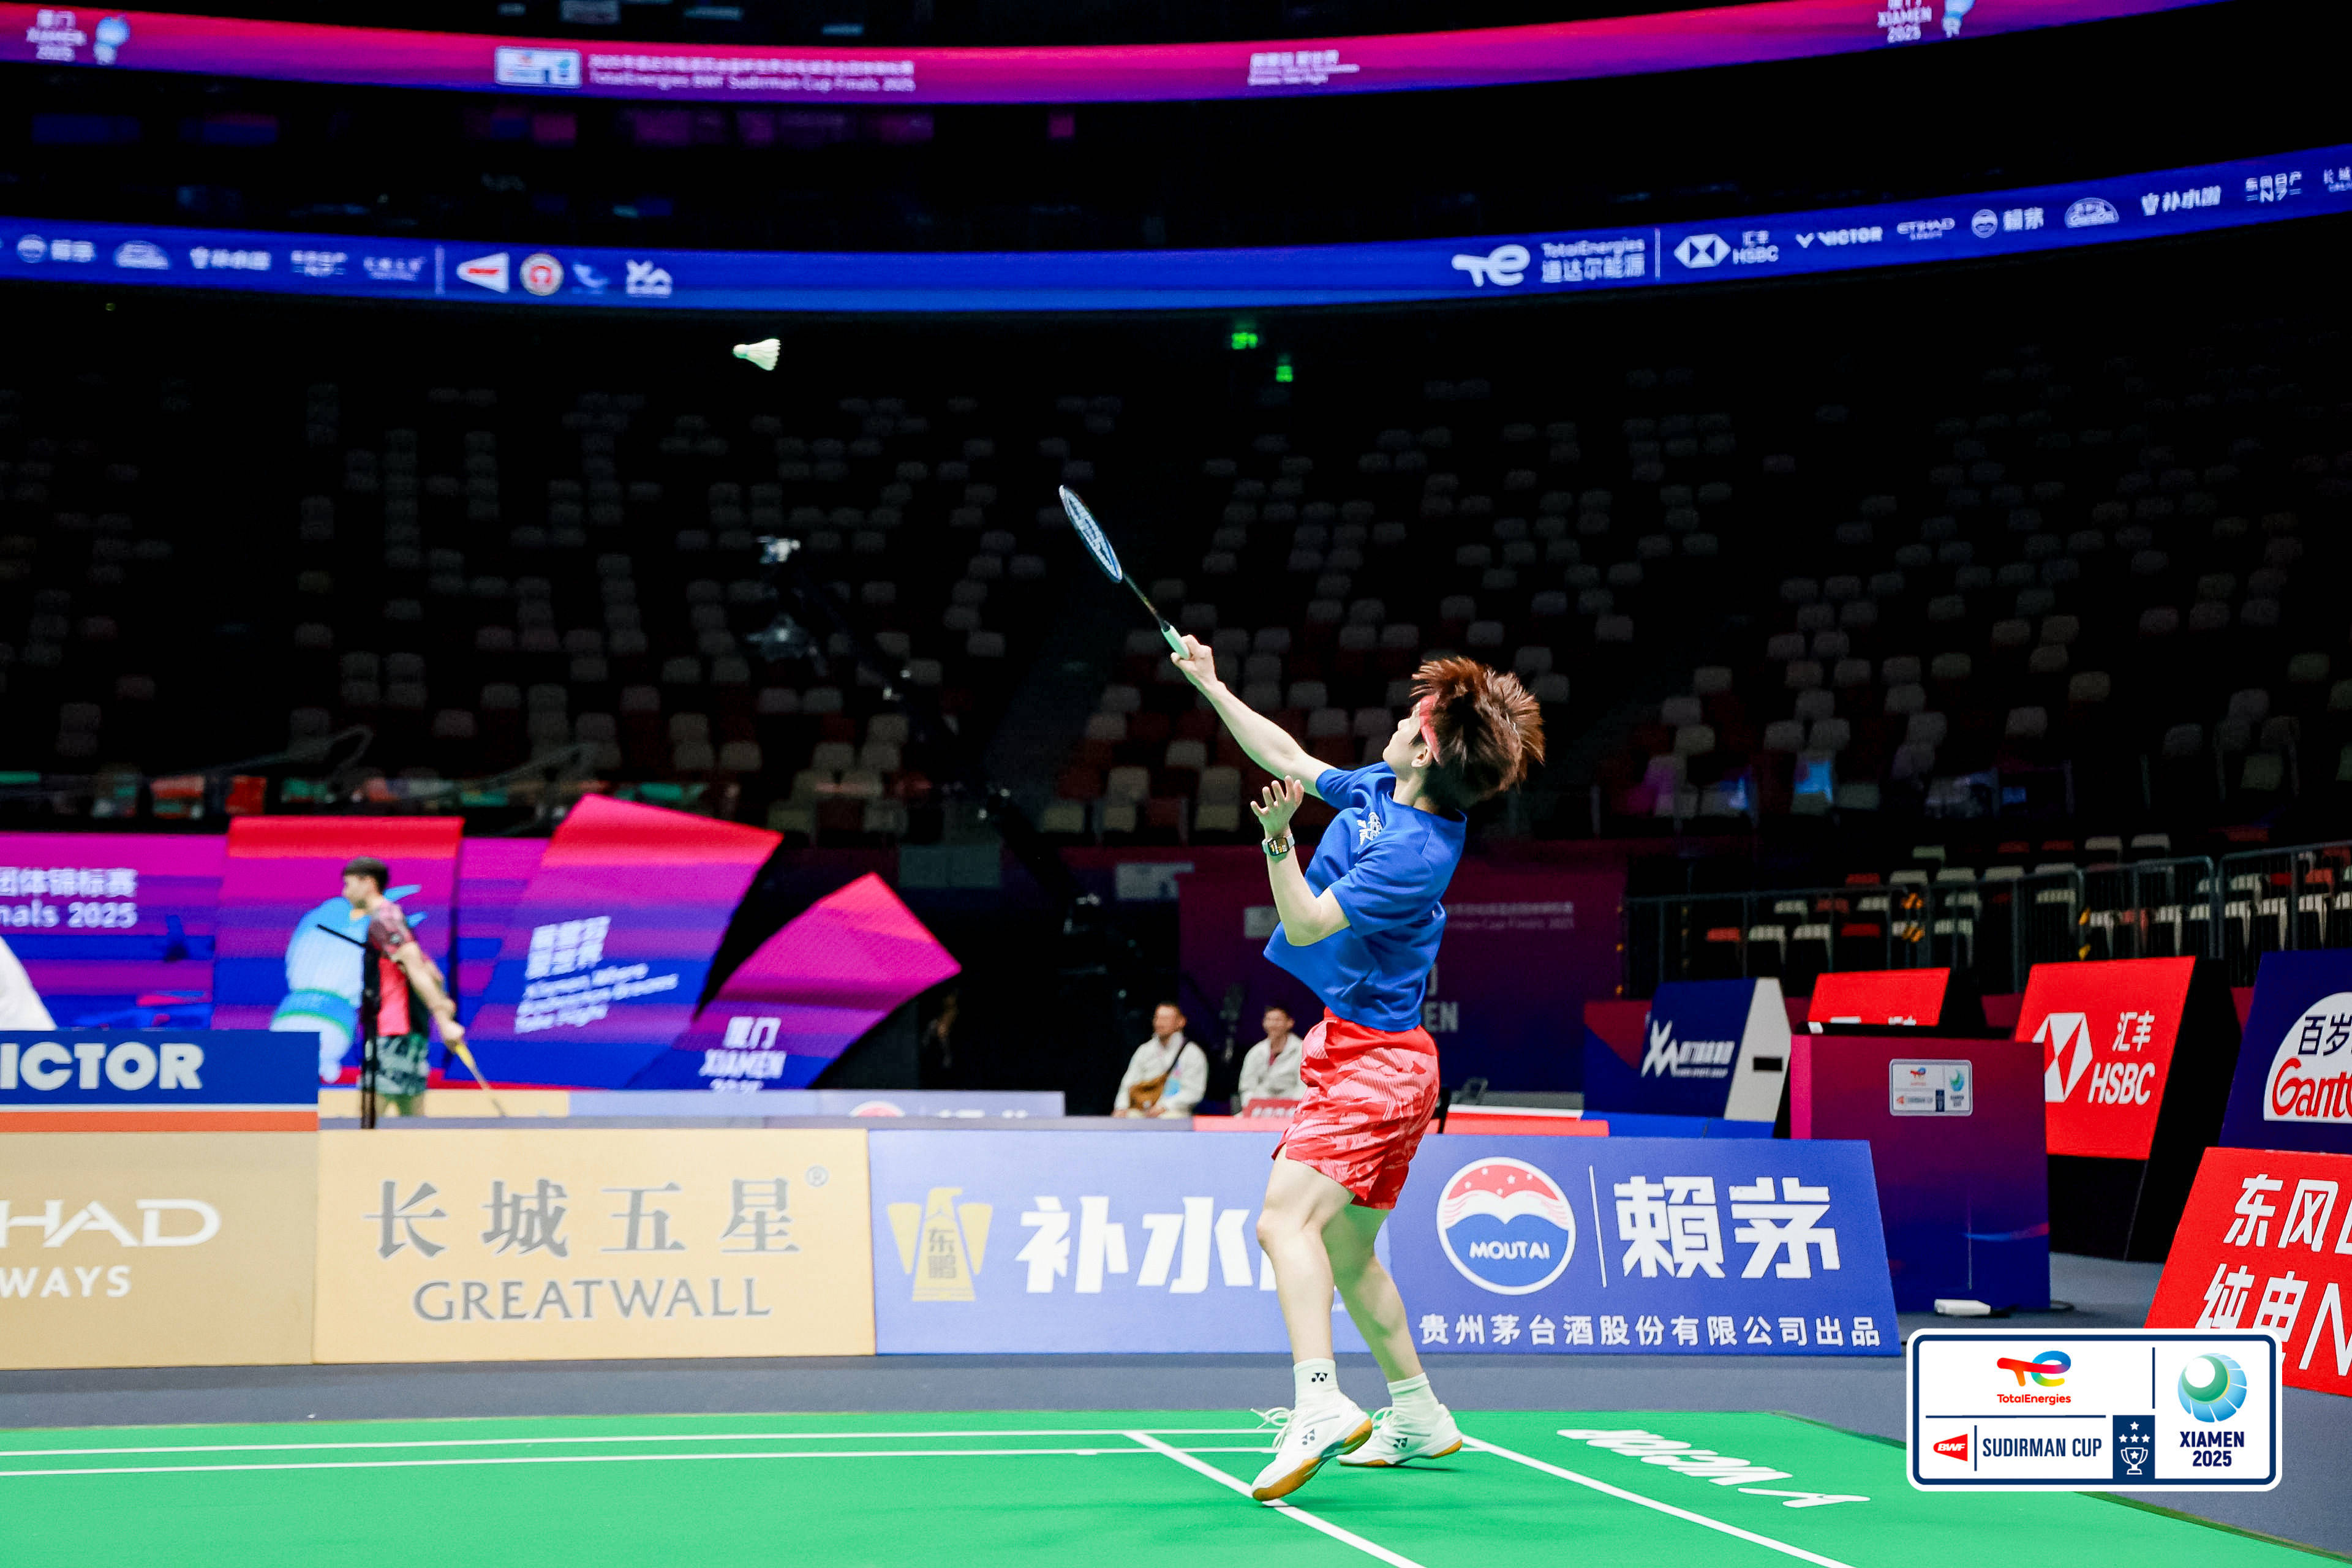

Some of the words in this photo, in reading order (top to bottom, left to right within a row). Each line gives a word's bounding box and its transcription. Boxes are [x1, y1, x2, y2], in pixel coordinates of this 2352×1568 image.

[68, 902, 137, 928] 2025
[2112, 1010, 2155, 1052] 汇丰
[2297, 1012, 2352, 1057] 百岁
[0, 1041, 204, 1091] ICTOR
[2087, 1061, 2155, 1105] HSBC
[364, 1178, 800, 1259] 长城五星
[1015, 1196, 1278, 1294] 补水
[1469, 1240, 1551, 1260] MOUTAI
[0, 1265, 132, 1298] WAYS
[413, 1278, 771, 1322] GREATWALL
[1419, 1313, 1880, 1347] 贵州茅台酒股份有限公司出品
